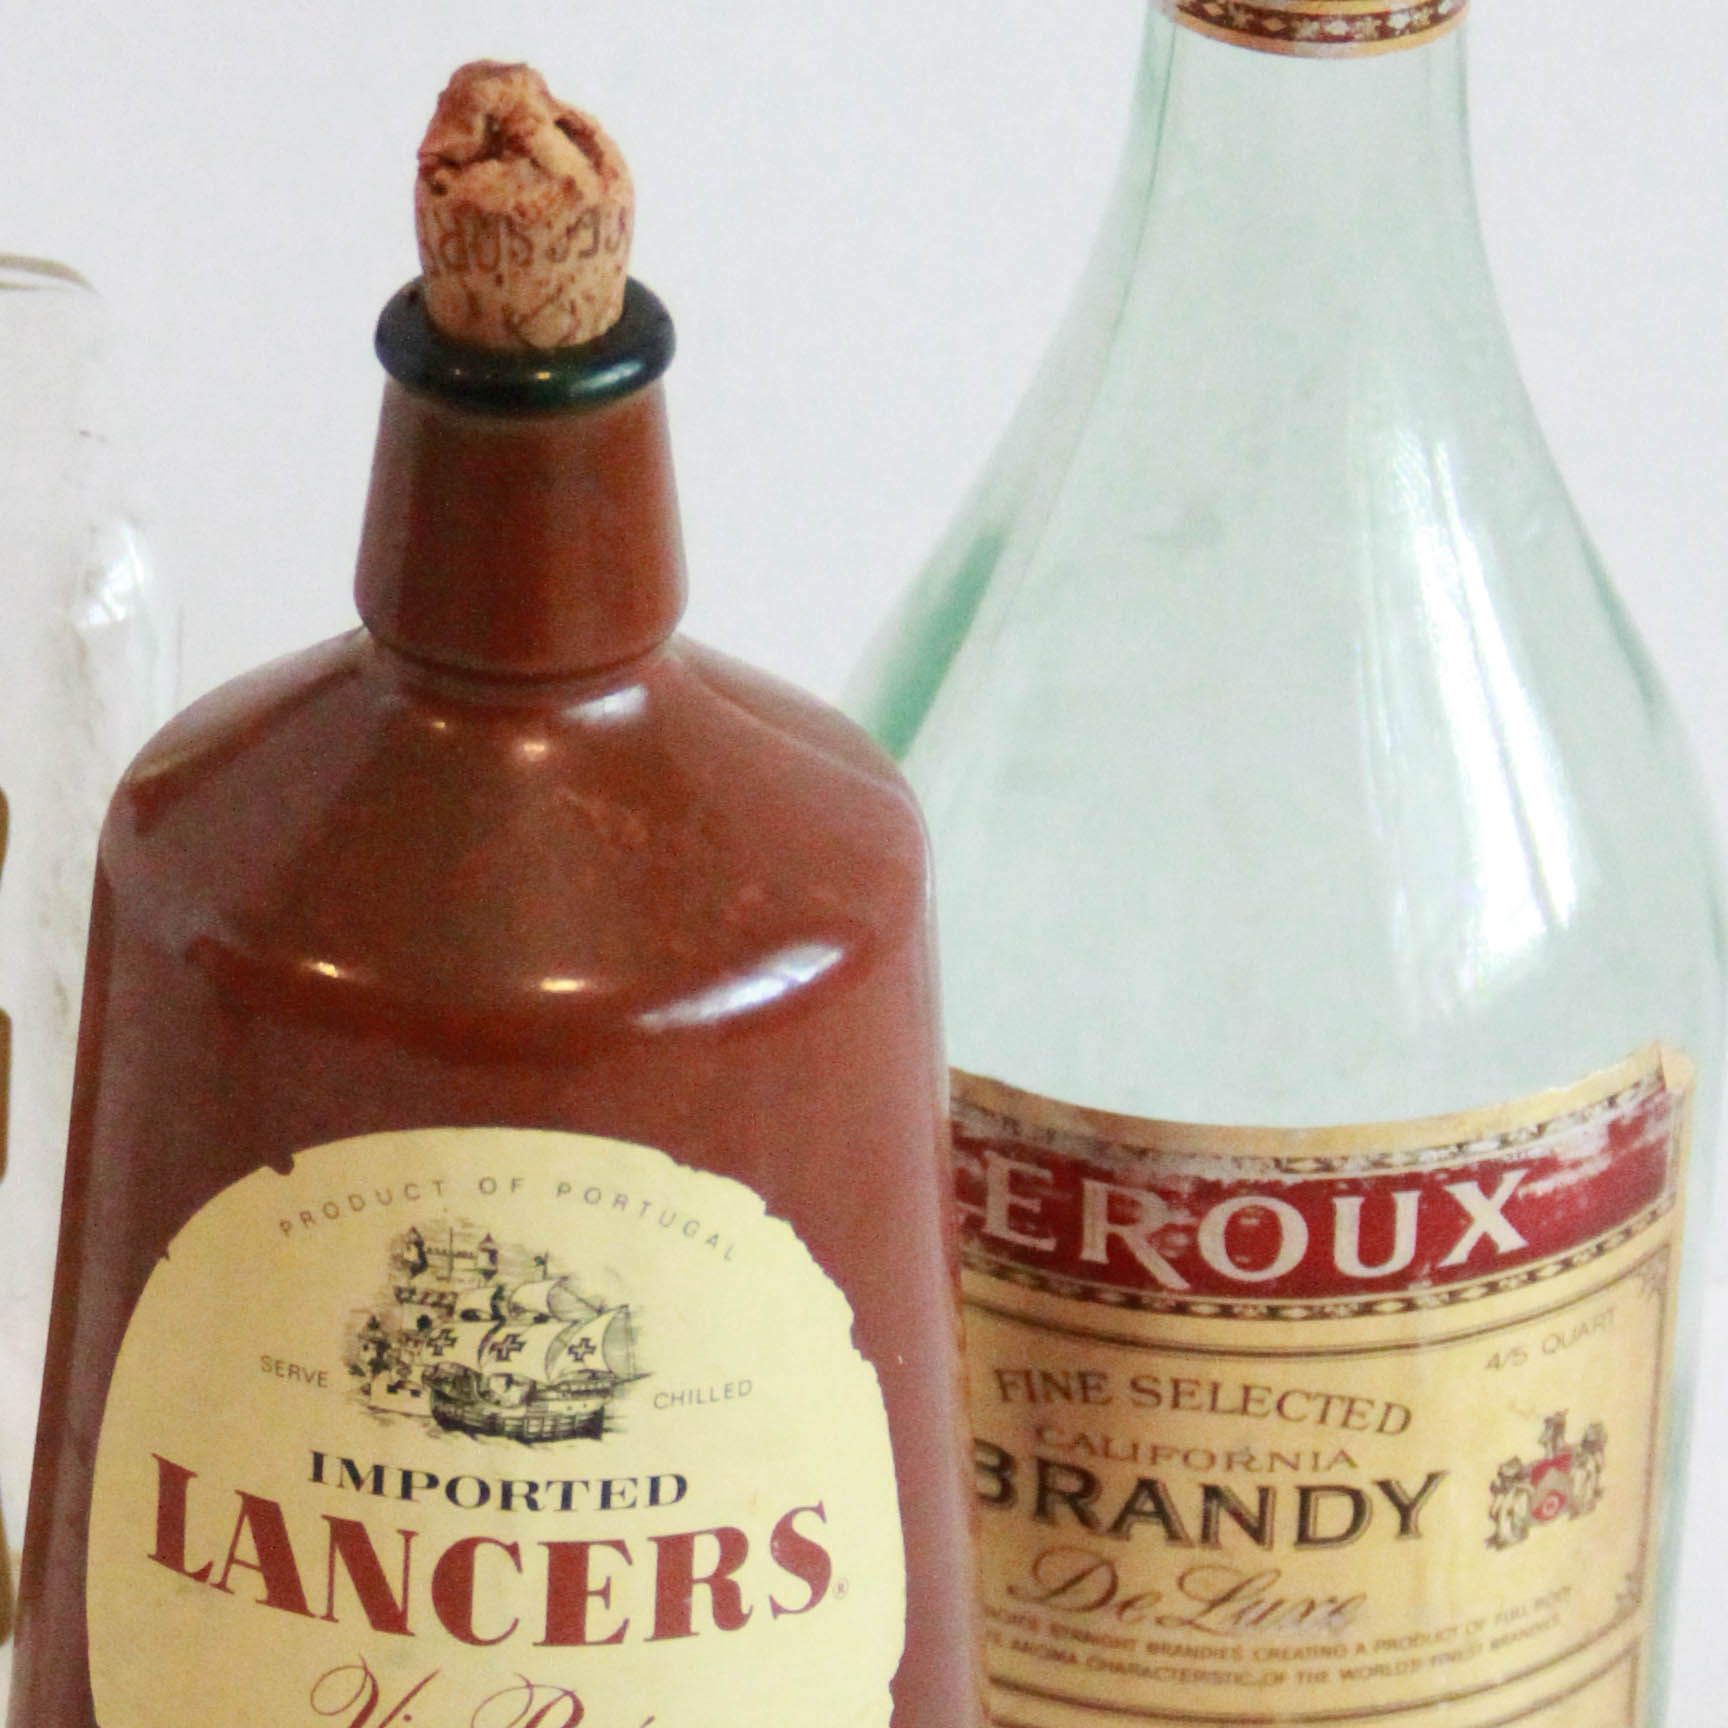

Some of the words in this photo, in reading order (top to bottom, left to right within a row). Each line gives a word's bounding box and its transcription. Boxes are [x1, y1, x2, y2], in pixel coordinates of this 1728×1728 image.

[279, 1178, 448, 1238] PRODUCT
[479, 1175, 527, 1197] OF
[556, 1181, 739, 1264] PORTUGAL
[955, 1146, 1529, 1290] EROUX
[258, 1353, 331, 1389] SERVE
[653, 1377, 754, 1411] CHILLED
[996, 1368, 1114, 1406] FINE
[1130, 1374, 1415, 1437] SELECTED
[308, 1449, 689, 1512] IMPORTED
[1035, 1423, 1359, 1472] CALIFORNIA
[973, 1437, 1450, 1551] BRANDY
[146, 1452, 836, 1648] LANCERS
[1007, 1546, 1163, 1626] De
